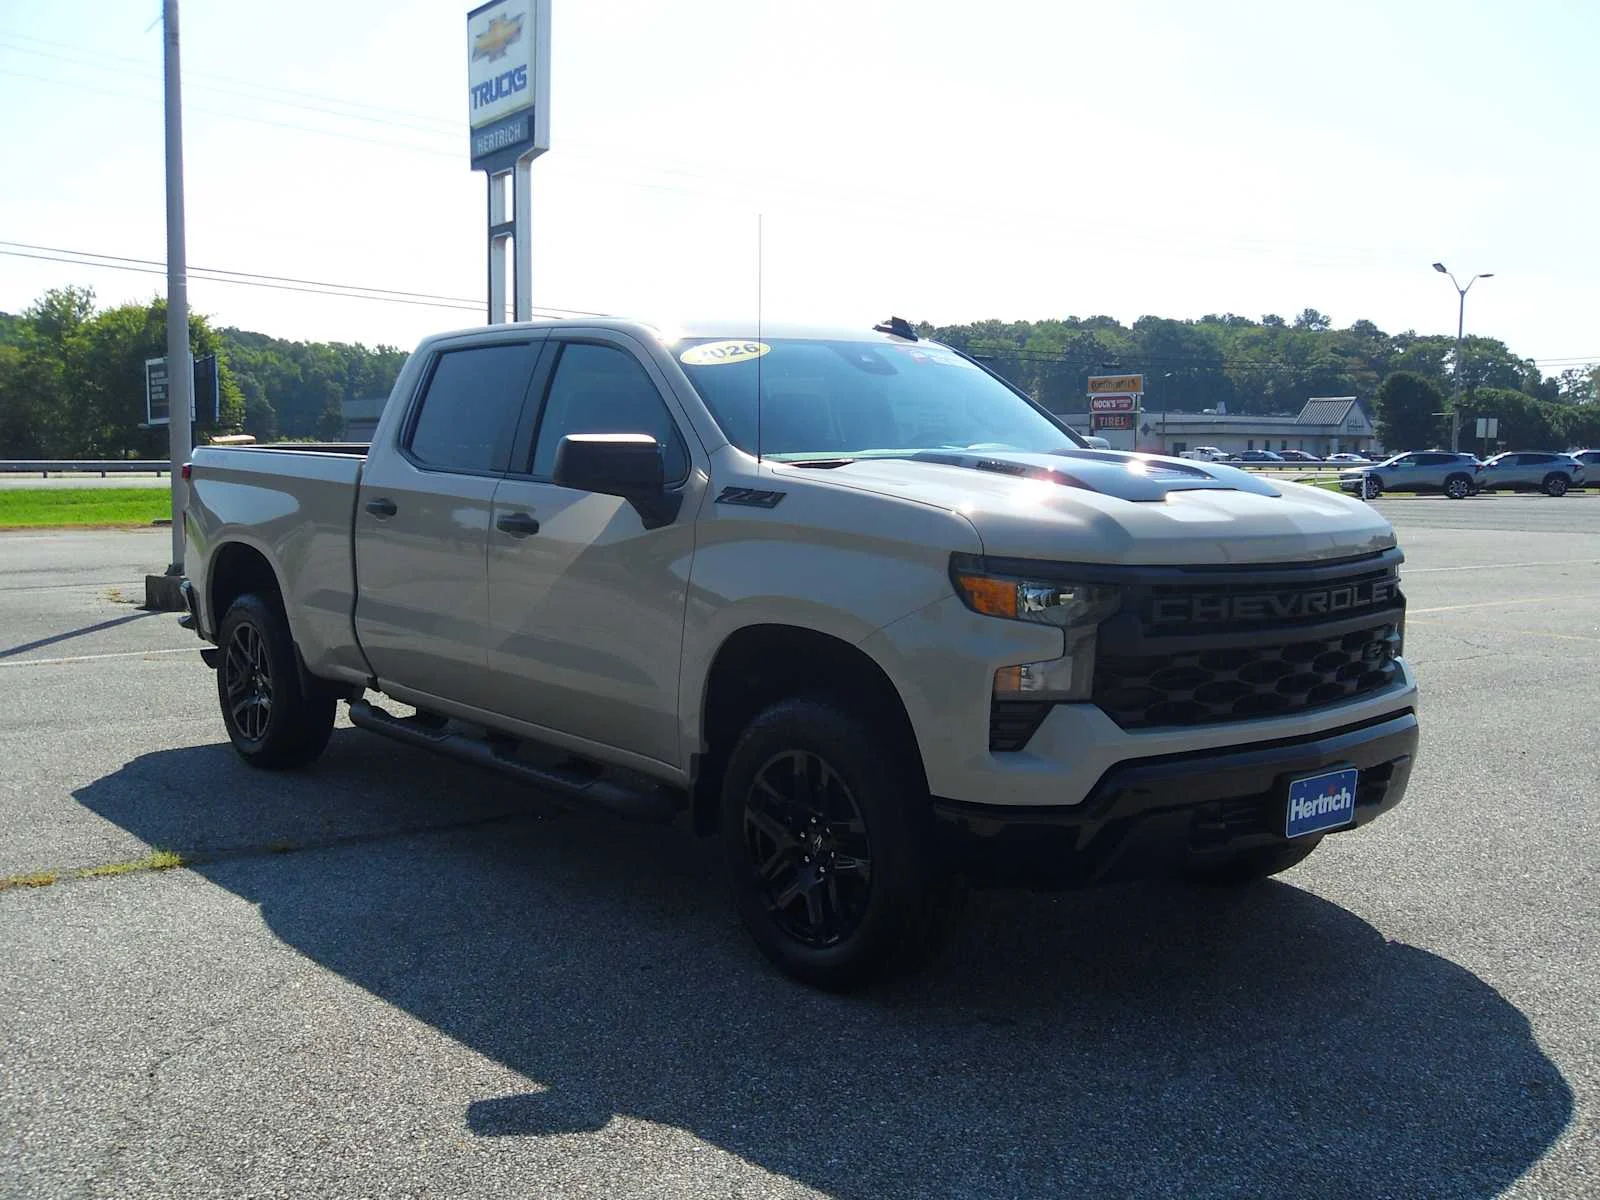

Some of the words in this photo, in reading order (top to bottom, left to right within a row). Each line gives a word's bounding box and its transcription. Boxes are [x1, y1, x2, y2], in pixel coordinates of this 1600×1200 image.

[471, 64, 527, 110] TRUCKS
[477, 122, 521, 153] HERTRICH
[1099, 415, 1126, 427] TIRES
[1290, 780, 1351, 822] Hertrich
